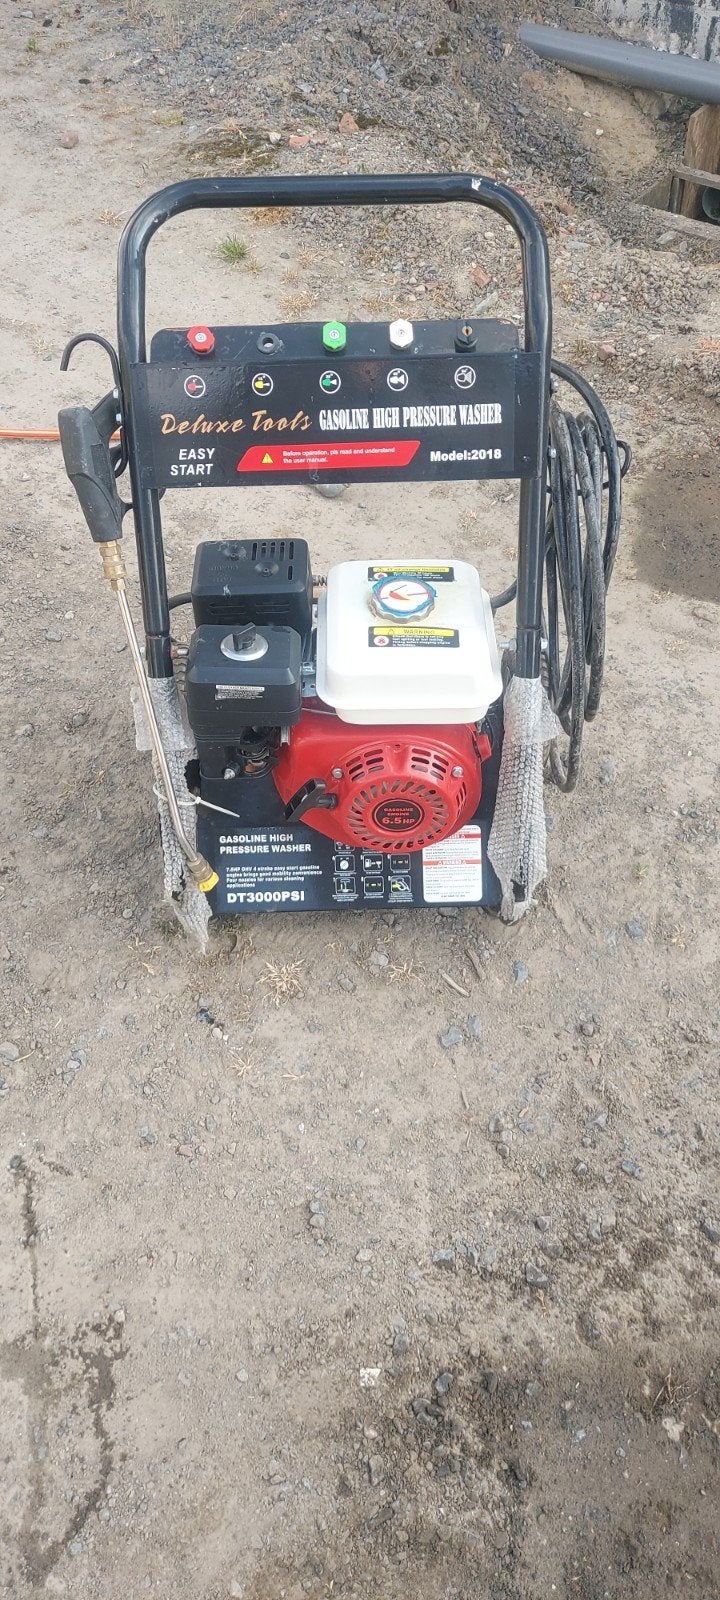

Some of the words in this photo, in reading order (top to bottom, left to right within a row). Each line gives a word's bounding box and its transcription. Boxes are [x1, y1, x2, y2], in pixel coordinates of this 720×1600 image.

[160, 413, 246, 435] Deluxe
[252, 410, 313, 432] Tools
[319, 408, 369, 430] GASOLINE
[373, 407, 400, 429] HIGH
[403, 405, 456, 427] PRESSURE
[459, 403, 502, 426] WASHER
[178, 448, 215, 461] EASY
[430, 449, 502, 462] Model:2018
[170, 463, 214, 476] START
[219, 834, 267, 844] GASOLINE
[269, 833, 294, 842] HIGH
[220, 845, 270, 855] PRESSURE
[271, 843, 312, 853] WASHER
[227, 890, 305, 903] DT3000PSI
